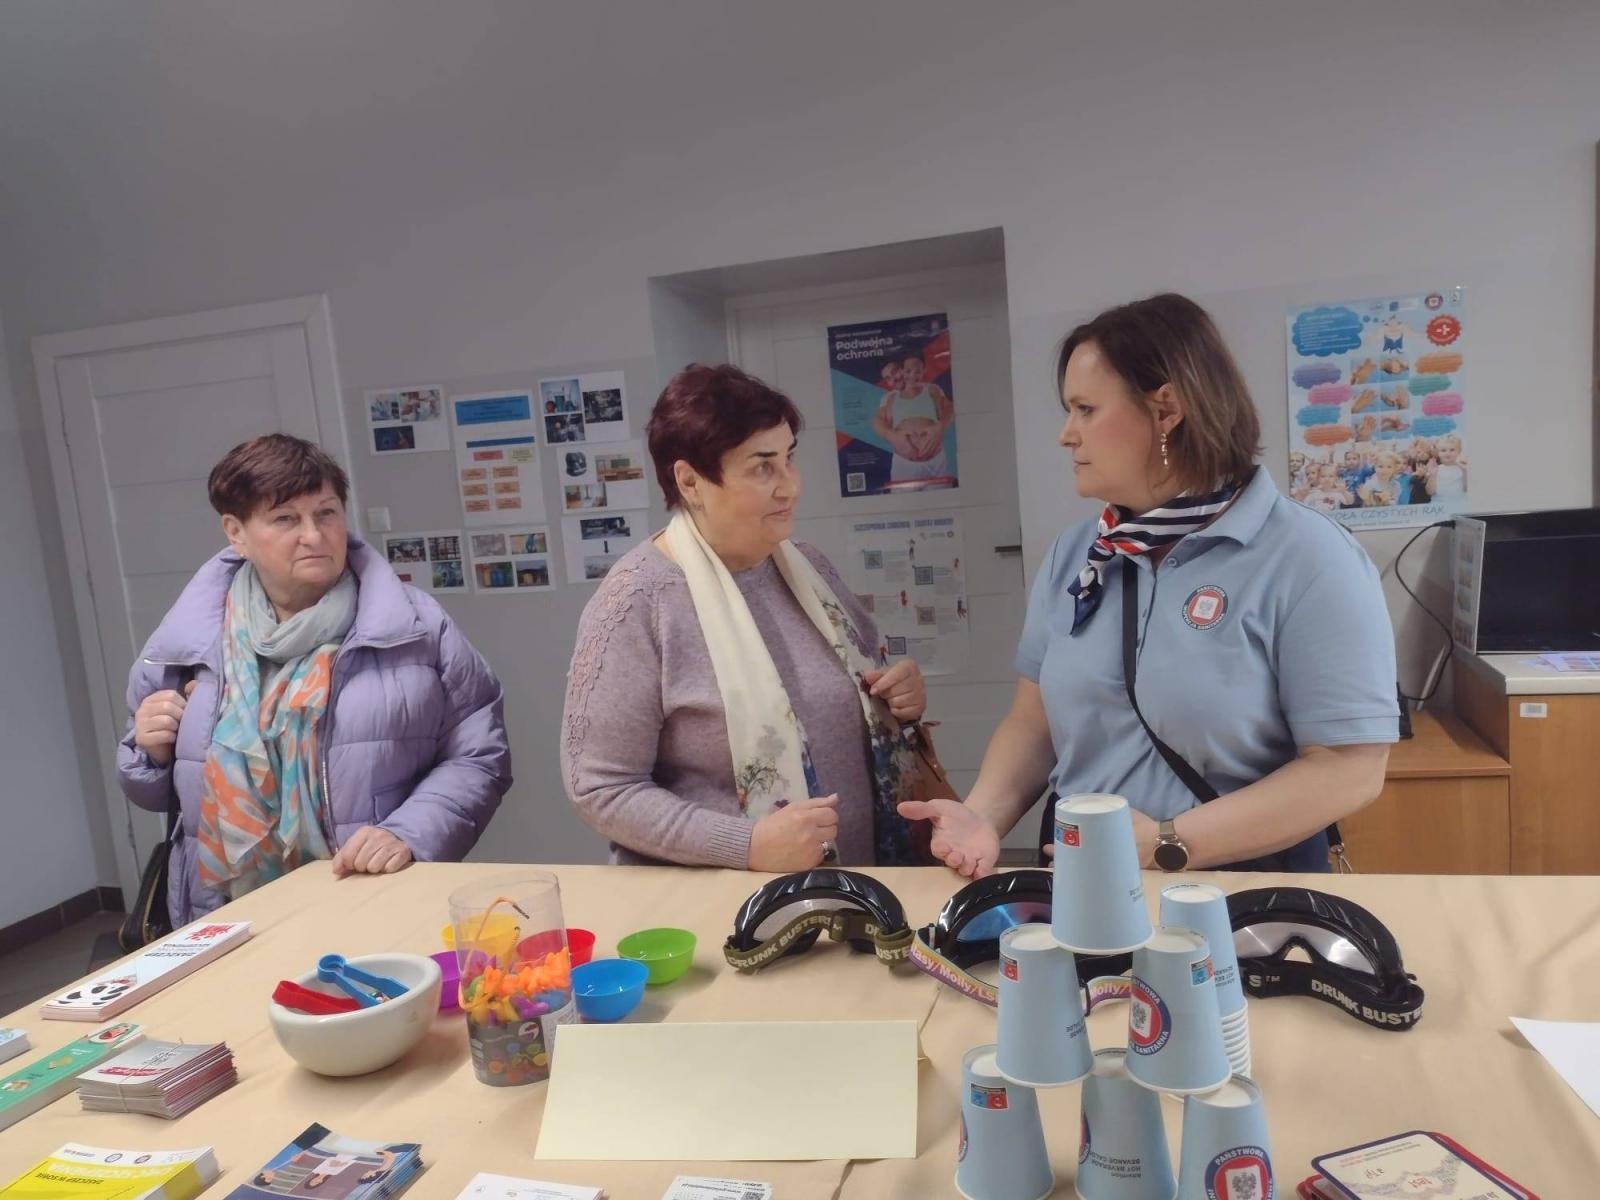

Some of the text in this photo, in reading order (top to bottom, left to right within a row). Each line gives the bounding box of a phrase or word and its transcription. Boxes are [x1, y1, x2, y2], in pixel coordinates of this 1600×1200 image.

[835, 336, 893, 350] Podwójna
[837, 348, 884, 361] ochrona
[1360, 508, 1418, 519] CZYSTYCH
[727, 942, 779, 969] DRUNK
[1311, 978, 1361, 1014] DRUNK
[1136, 1031, 1169, 1055] SANITARNA
[1214, 1147, 1265, 1166] PAŃSTWOWA
